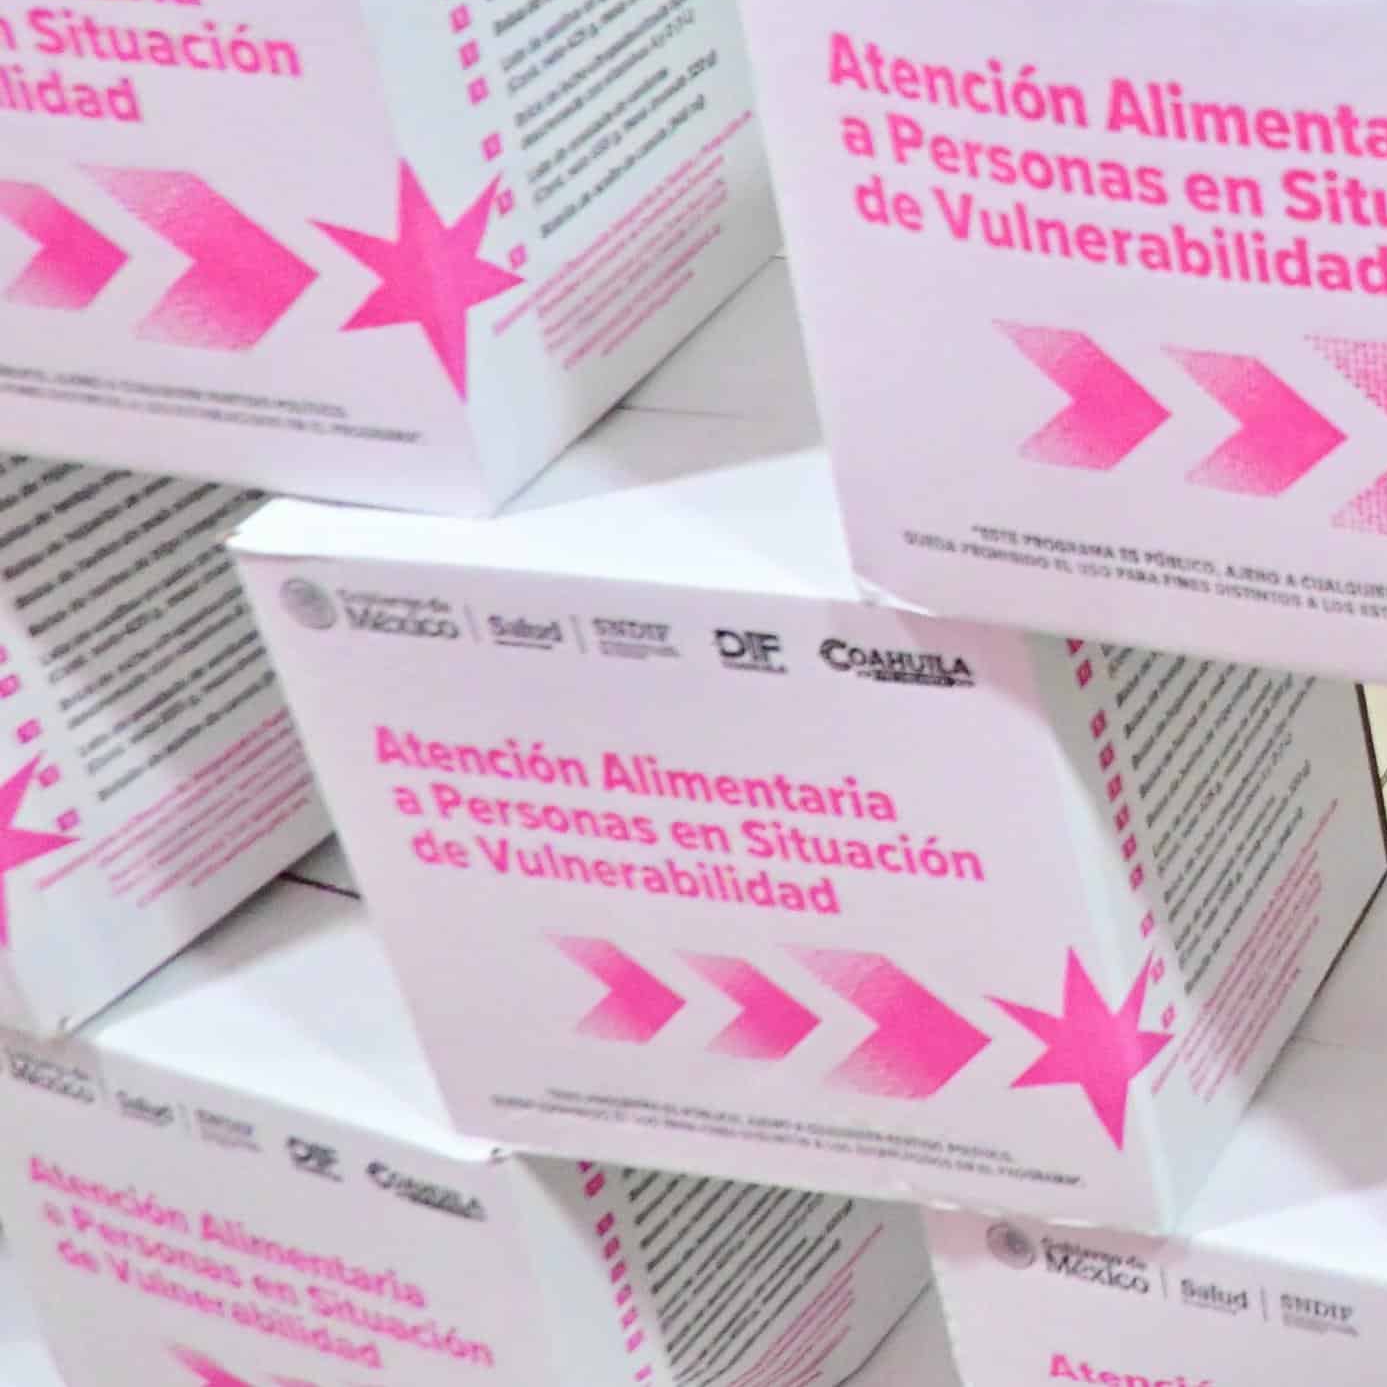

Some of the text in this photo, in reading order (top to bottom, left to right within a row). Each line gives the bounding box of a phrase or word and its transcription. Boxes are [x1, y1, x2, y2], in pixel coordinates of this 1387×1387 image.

[26, 7, 303, 78] Situación
[828, 34, 1089, 129] Atención
[841, 114, 877, 159] a
[886, 111, 1170, 207] Personas
[1183, 171, 1265, 219] en
[853, 177, 925, 233] de
[961, 542, 1049, 570] PROHIBIDO
[1116, 566, 1161, 586] PARA
[1322, 597, 1355, 615] LOS
[1023, 533, 1114, 560] PROGRAMA
[1225, 565, 1281, 586] AJENO
[1285, 573, 1297, 587] A
[713, 628, 783, 664] DIF
[820, 637, 972, 676] COAHUILA
[374, 726, 897, 822] Atención Alimentaria
[392, 782, 986, 883] a Personas en Situación
[410, 830, 842, 916] de Vulnerabilidad
[30, 1158, 425, 1308] Atención Alimentaria
[70, 1209, 243, 1288] Personas
[306, 1286, 492, 1366] Situación
[112, 1260, 382, 1369] Vulnerabilidad
[1181, 1278, 1248, 1312] Salud
